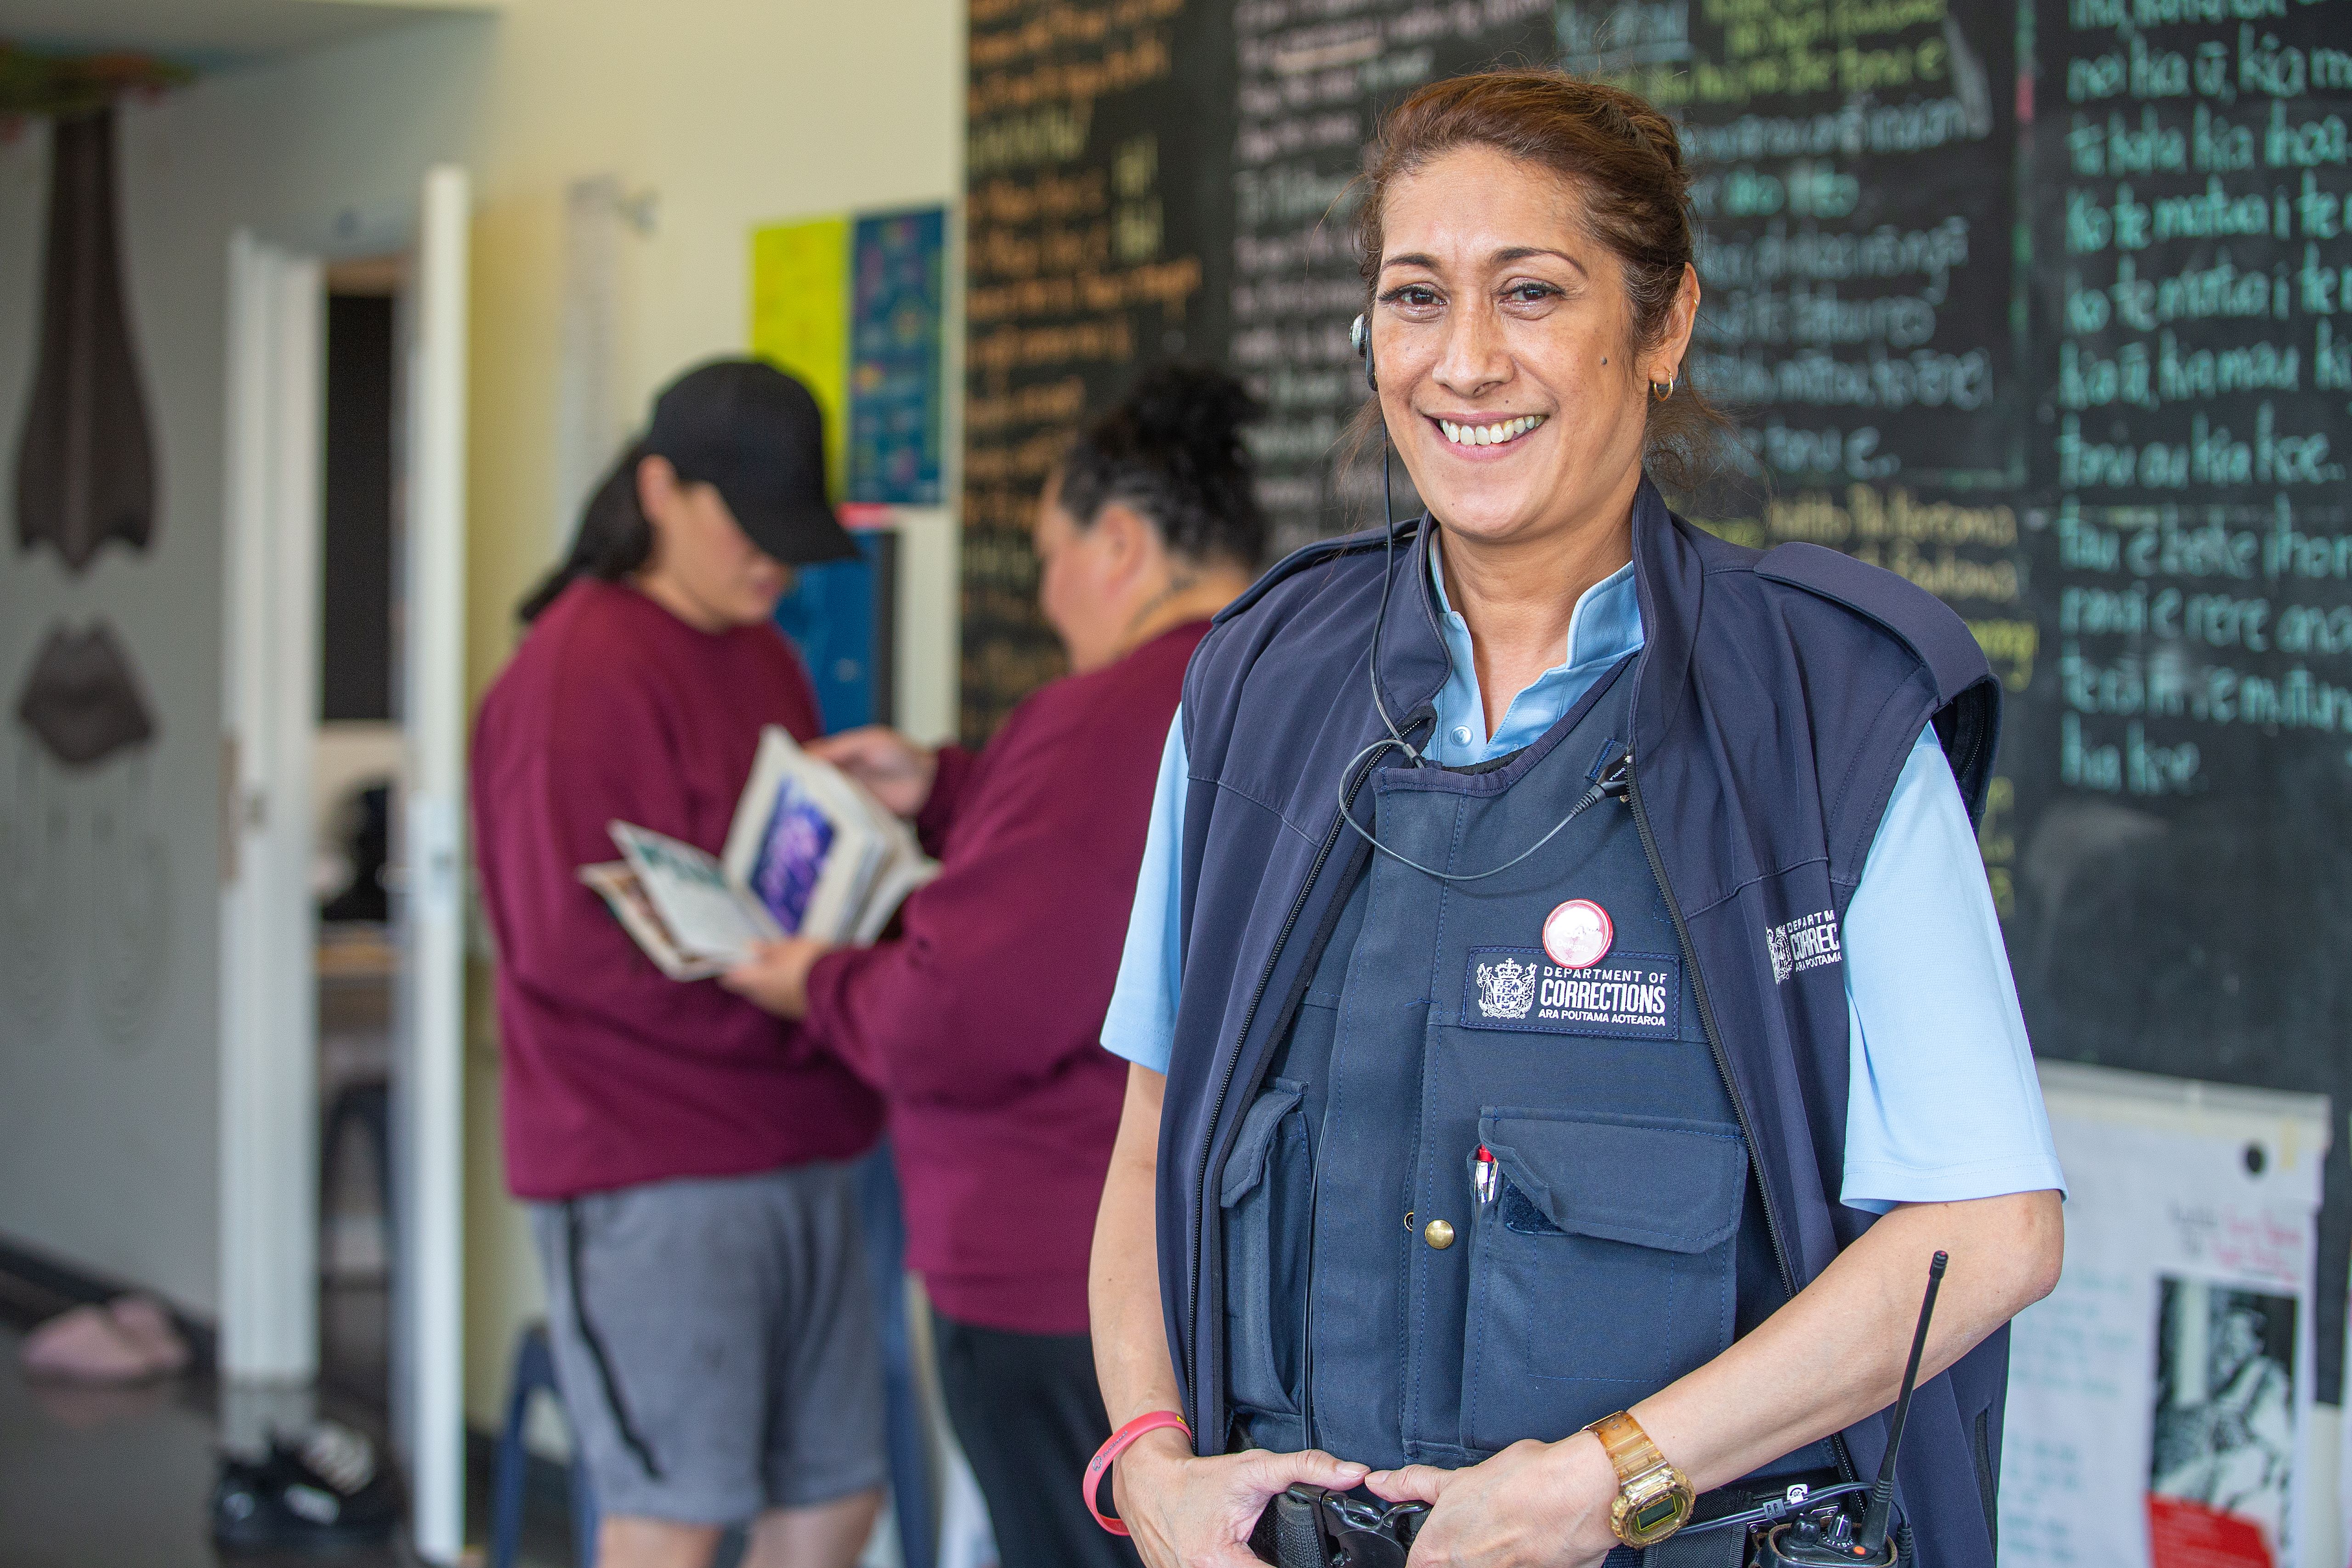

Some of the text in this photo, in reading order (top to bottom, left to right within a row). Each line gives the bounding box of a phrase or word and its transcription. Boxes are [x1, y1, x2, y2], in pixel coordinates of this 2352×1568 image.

[1610, 767, 1626, 781] OROLA
[1556, 939, 1589, 952] Delegate
[1543, 966, 1667, 984] DEPARTMENT OF
[1540, 978, 1666, 1013] CORRECTIONS
[1538, 1008, 1666, 1026] ARA POUTAMA AOTEAROA
